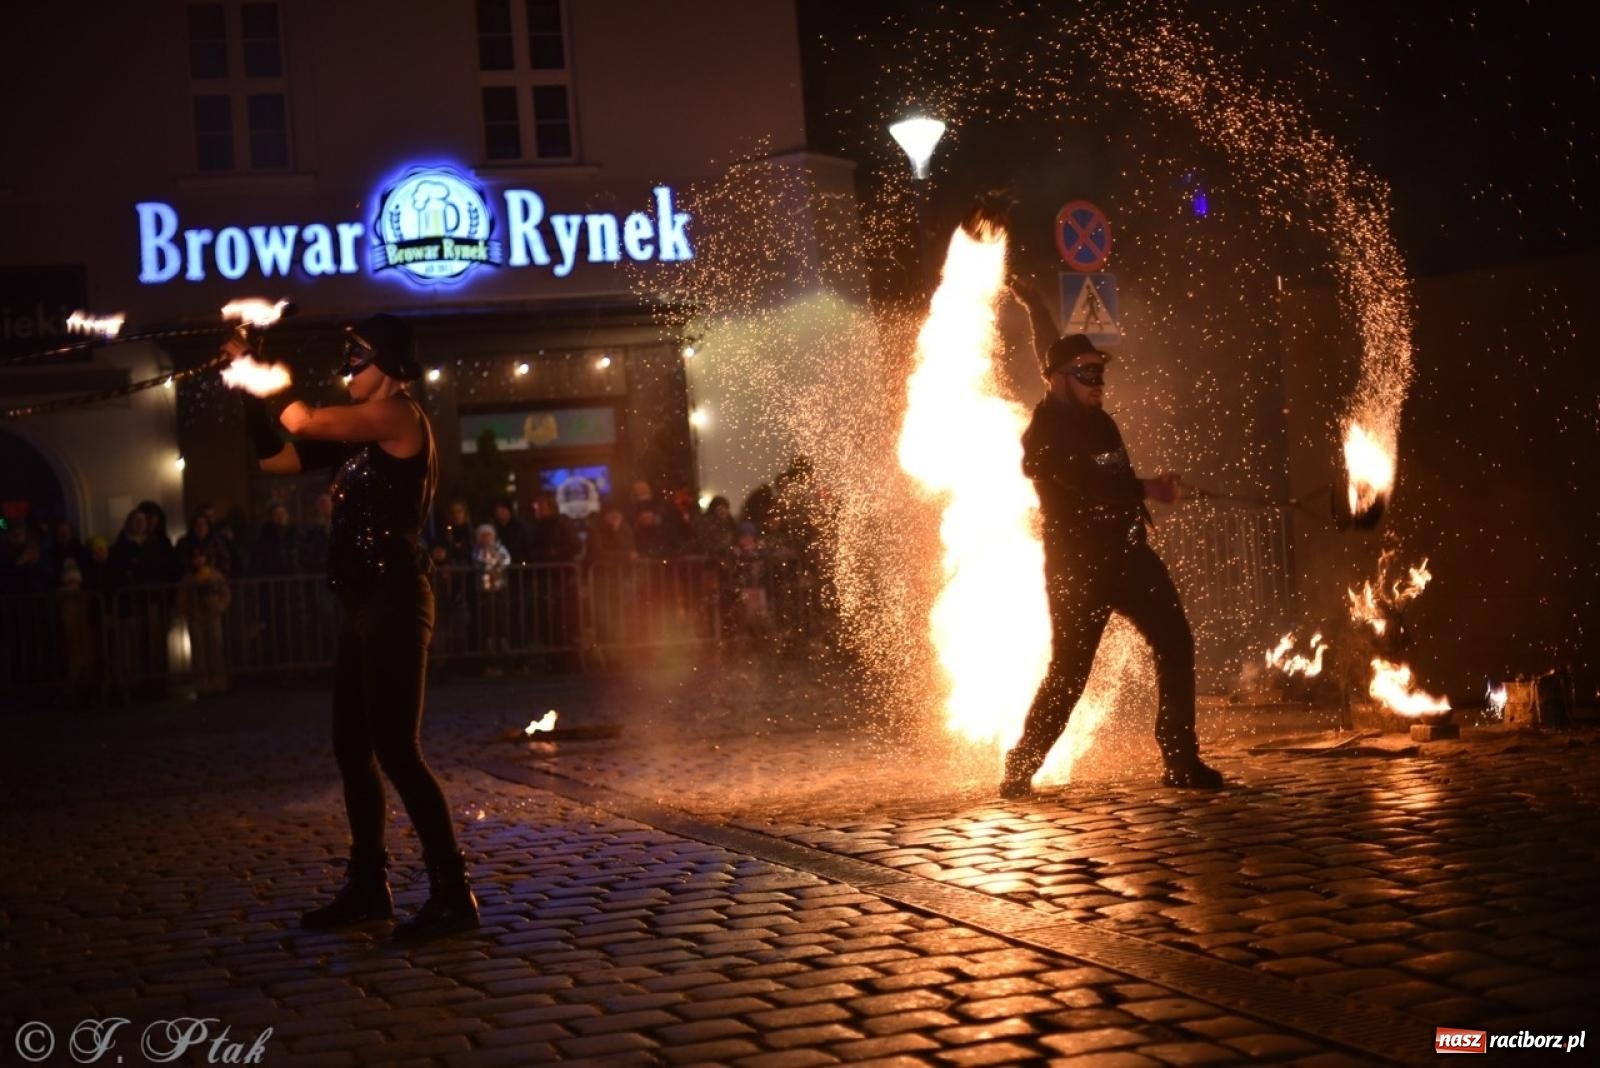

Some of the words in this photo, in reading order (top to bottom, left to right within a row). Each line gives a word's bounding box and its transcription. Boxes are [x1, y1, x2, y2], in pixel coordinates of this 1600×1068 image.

[136, 201, 364, 284] Browar
[503, 186, 695, 277] Rynek
[385, 243, 440, 266] Browar
[442, 238, 488, 262] Rynek
